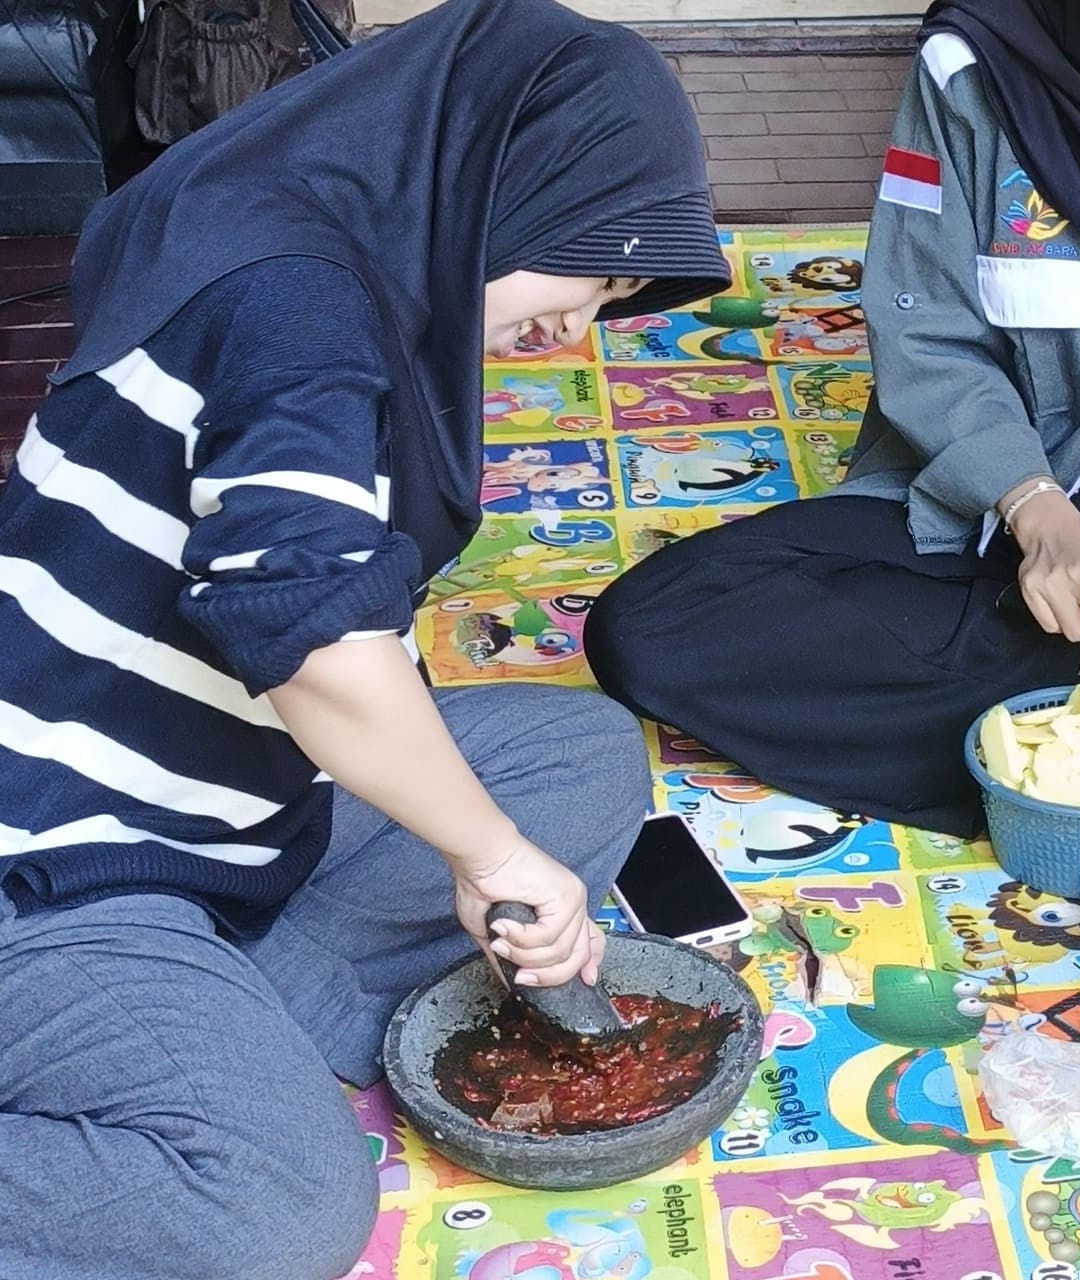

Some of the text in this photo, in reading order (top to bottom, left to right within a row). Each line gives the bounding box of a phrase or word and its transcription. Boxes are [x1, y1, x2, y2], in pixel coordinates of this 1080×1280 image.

[727, 1133, 760, 1151] 11
[452, 1208, 486, 1222] 8
[657, 1183, 698, 1258] elephant
